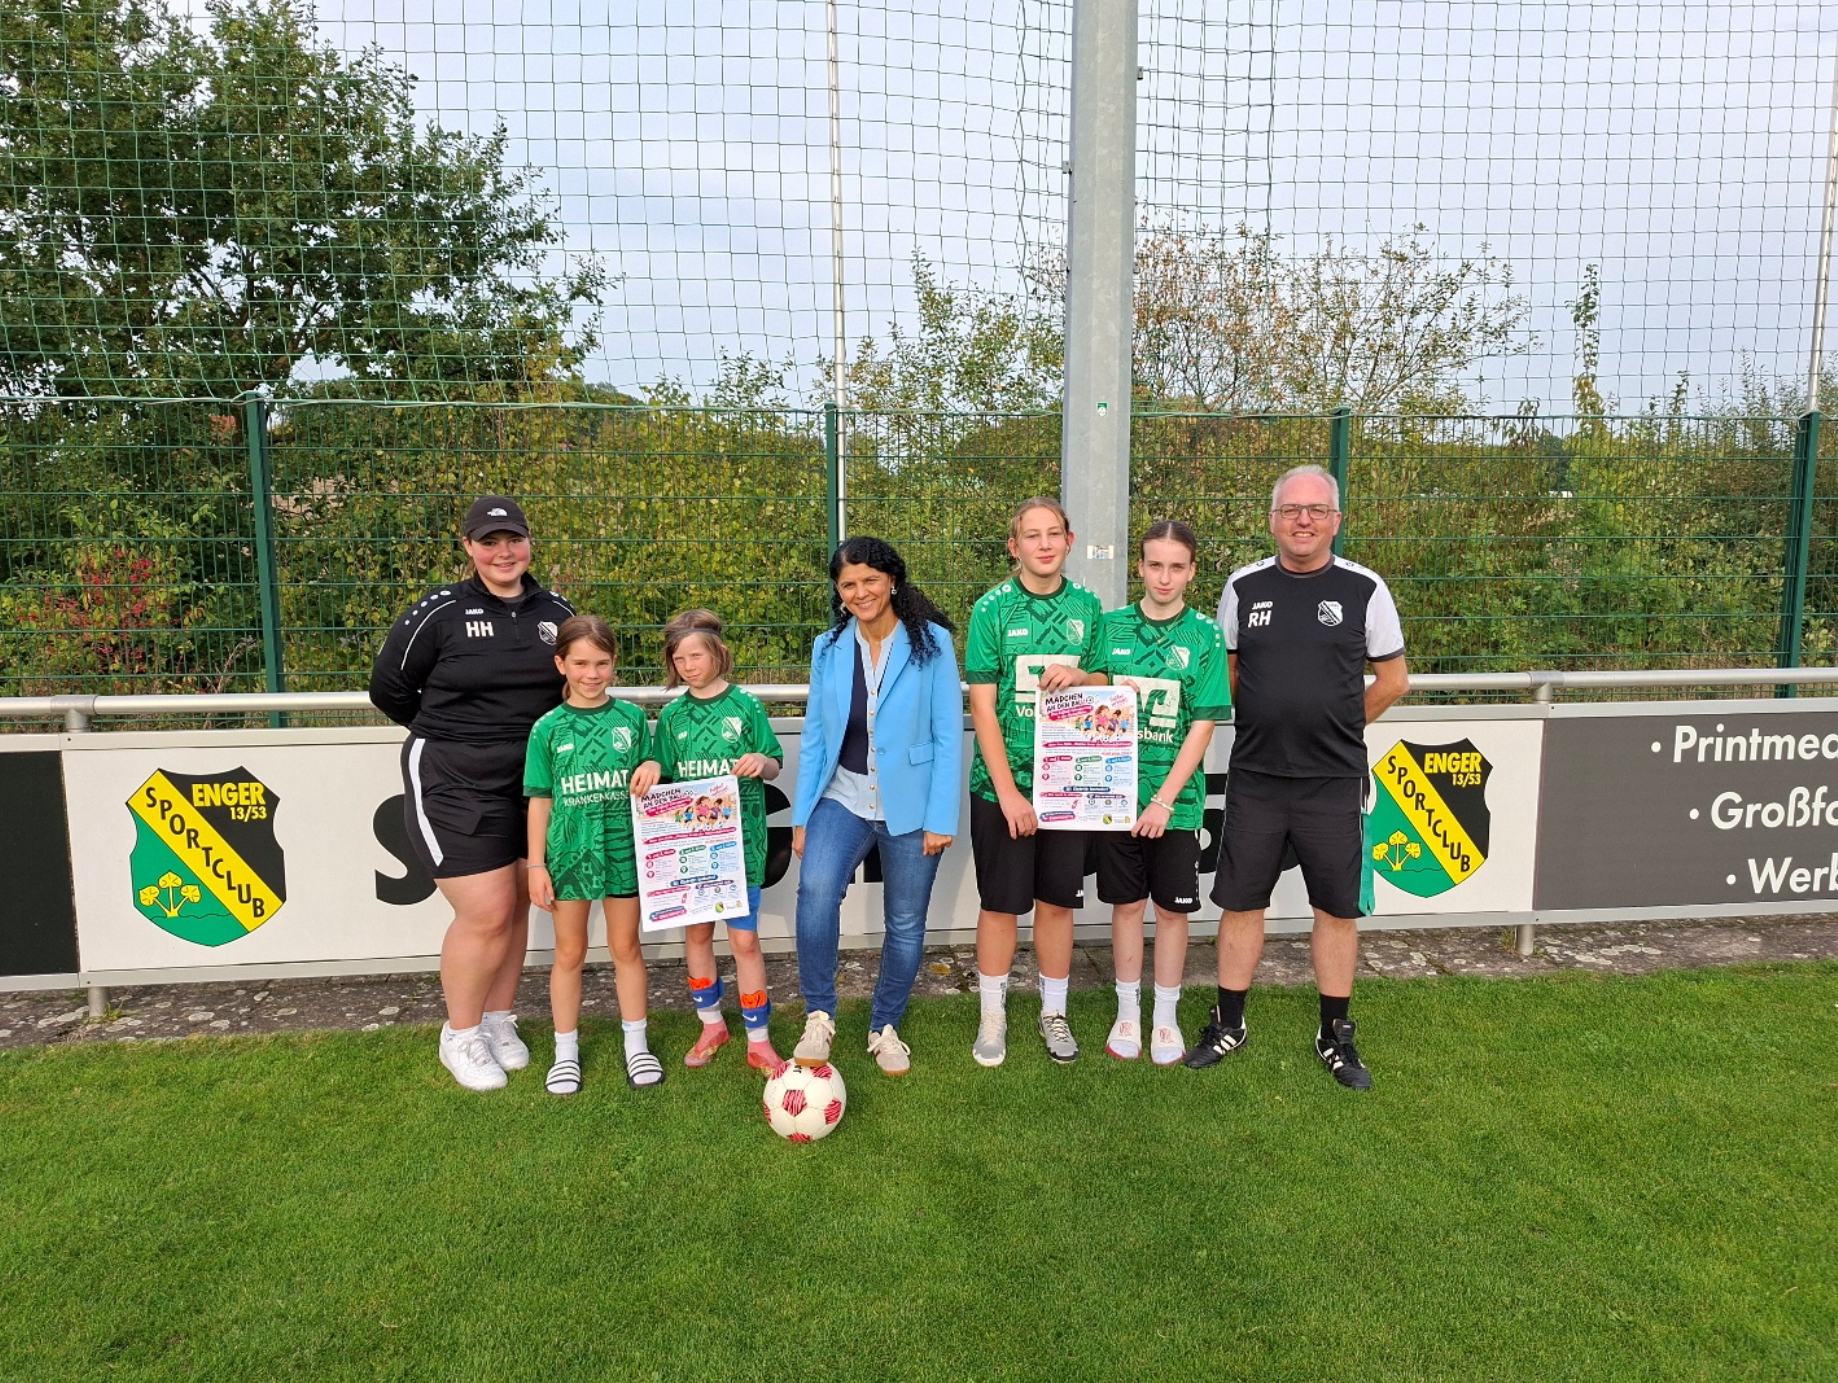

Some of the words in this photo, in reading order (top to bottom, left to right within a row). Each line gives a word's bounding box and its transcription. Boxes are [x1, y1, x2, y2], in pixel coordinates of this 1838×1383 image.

[1252, 601, 1273, 610] JAKO
[465, 621, 494, 637] HH
[1248, 610, 1272, 628] RH
[1423, 752, 1482, 774] ENGER
[560, 769, 629, 795] HEIMAT
[1452, 773, 1482, 788] 13/53
[192, 782, 266, 807] ENGER
[230, 805, 267, 822] 13/53
[1387, 755, 1471, 873] SPORTCLUB
[145, 787, 265, 918] SPORTCLUB
